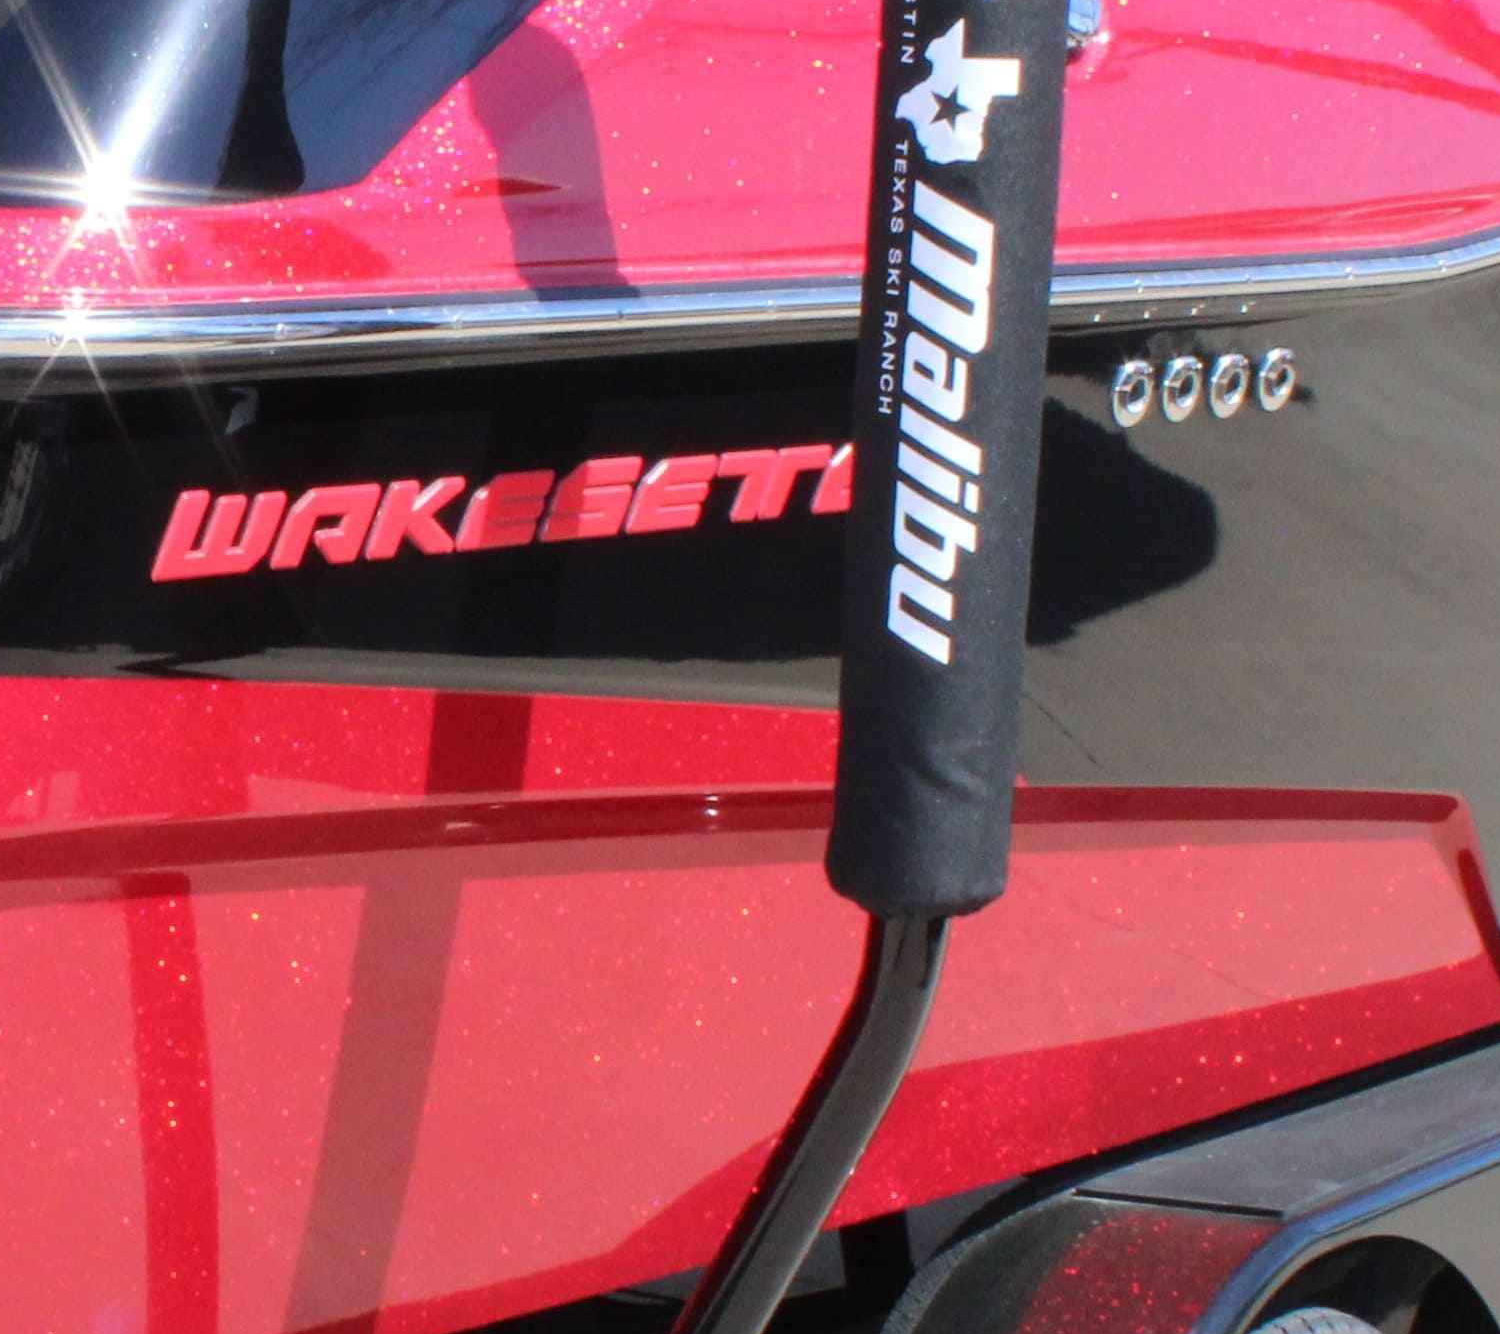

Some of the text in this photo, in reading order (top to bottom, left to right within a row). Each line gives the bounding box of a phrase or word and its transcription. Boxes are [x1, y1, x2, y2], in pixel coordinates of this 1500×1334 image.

[890, 139, 909, 234] TEXAS
[886, 248, 903, 296] SKI
[878, 310, 899, 415] RANCH
